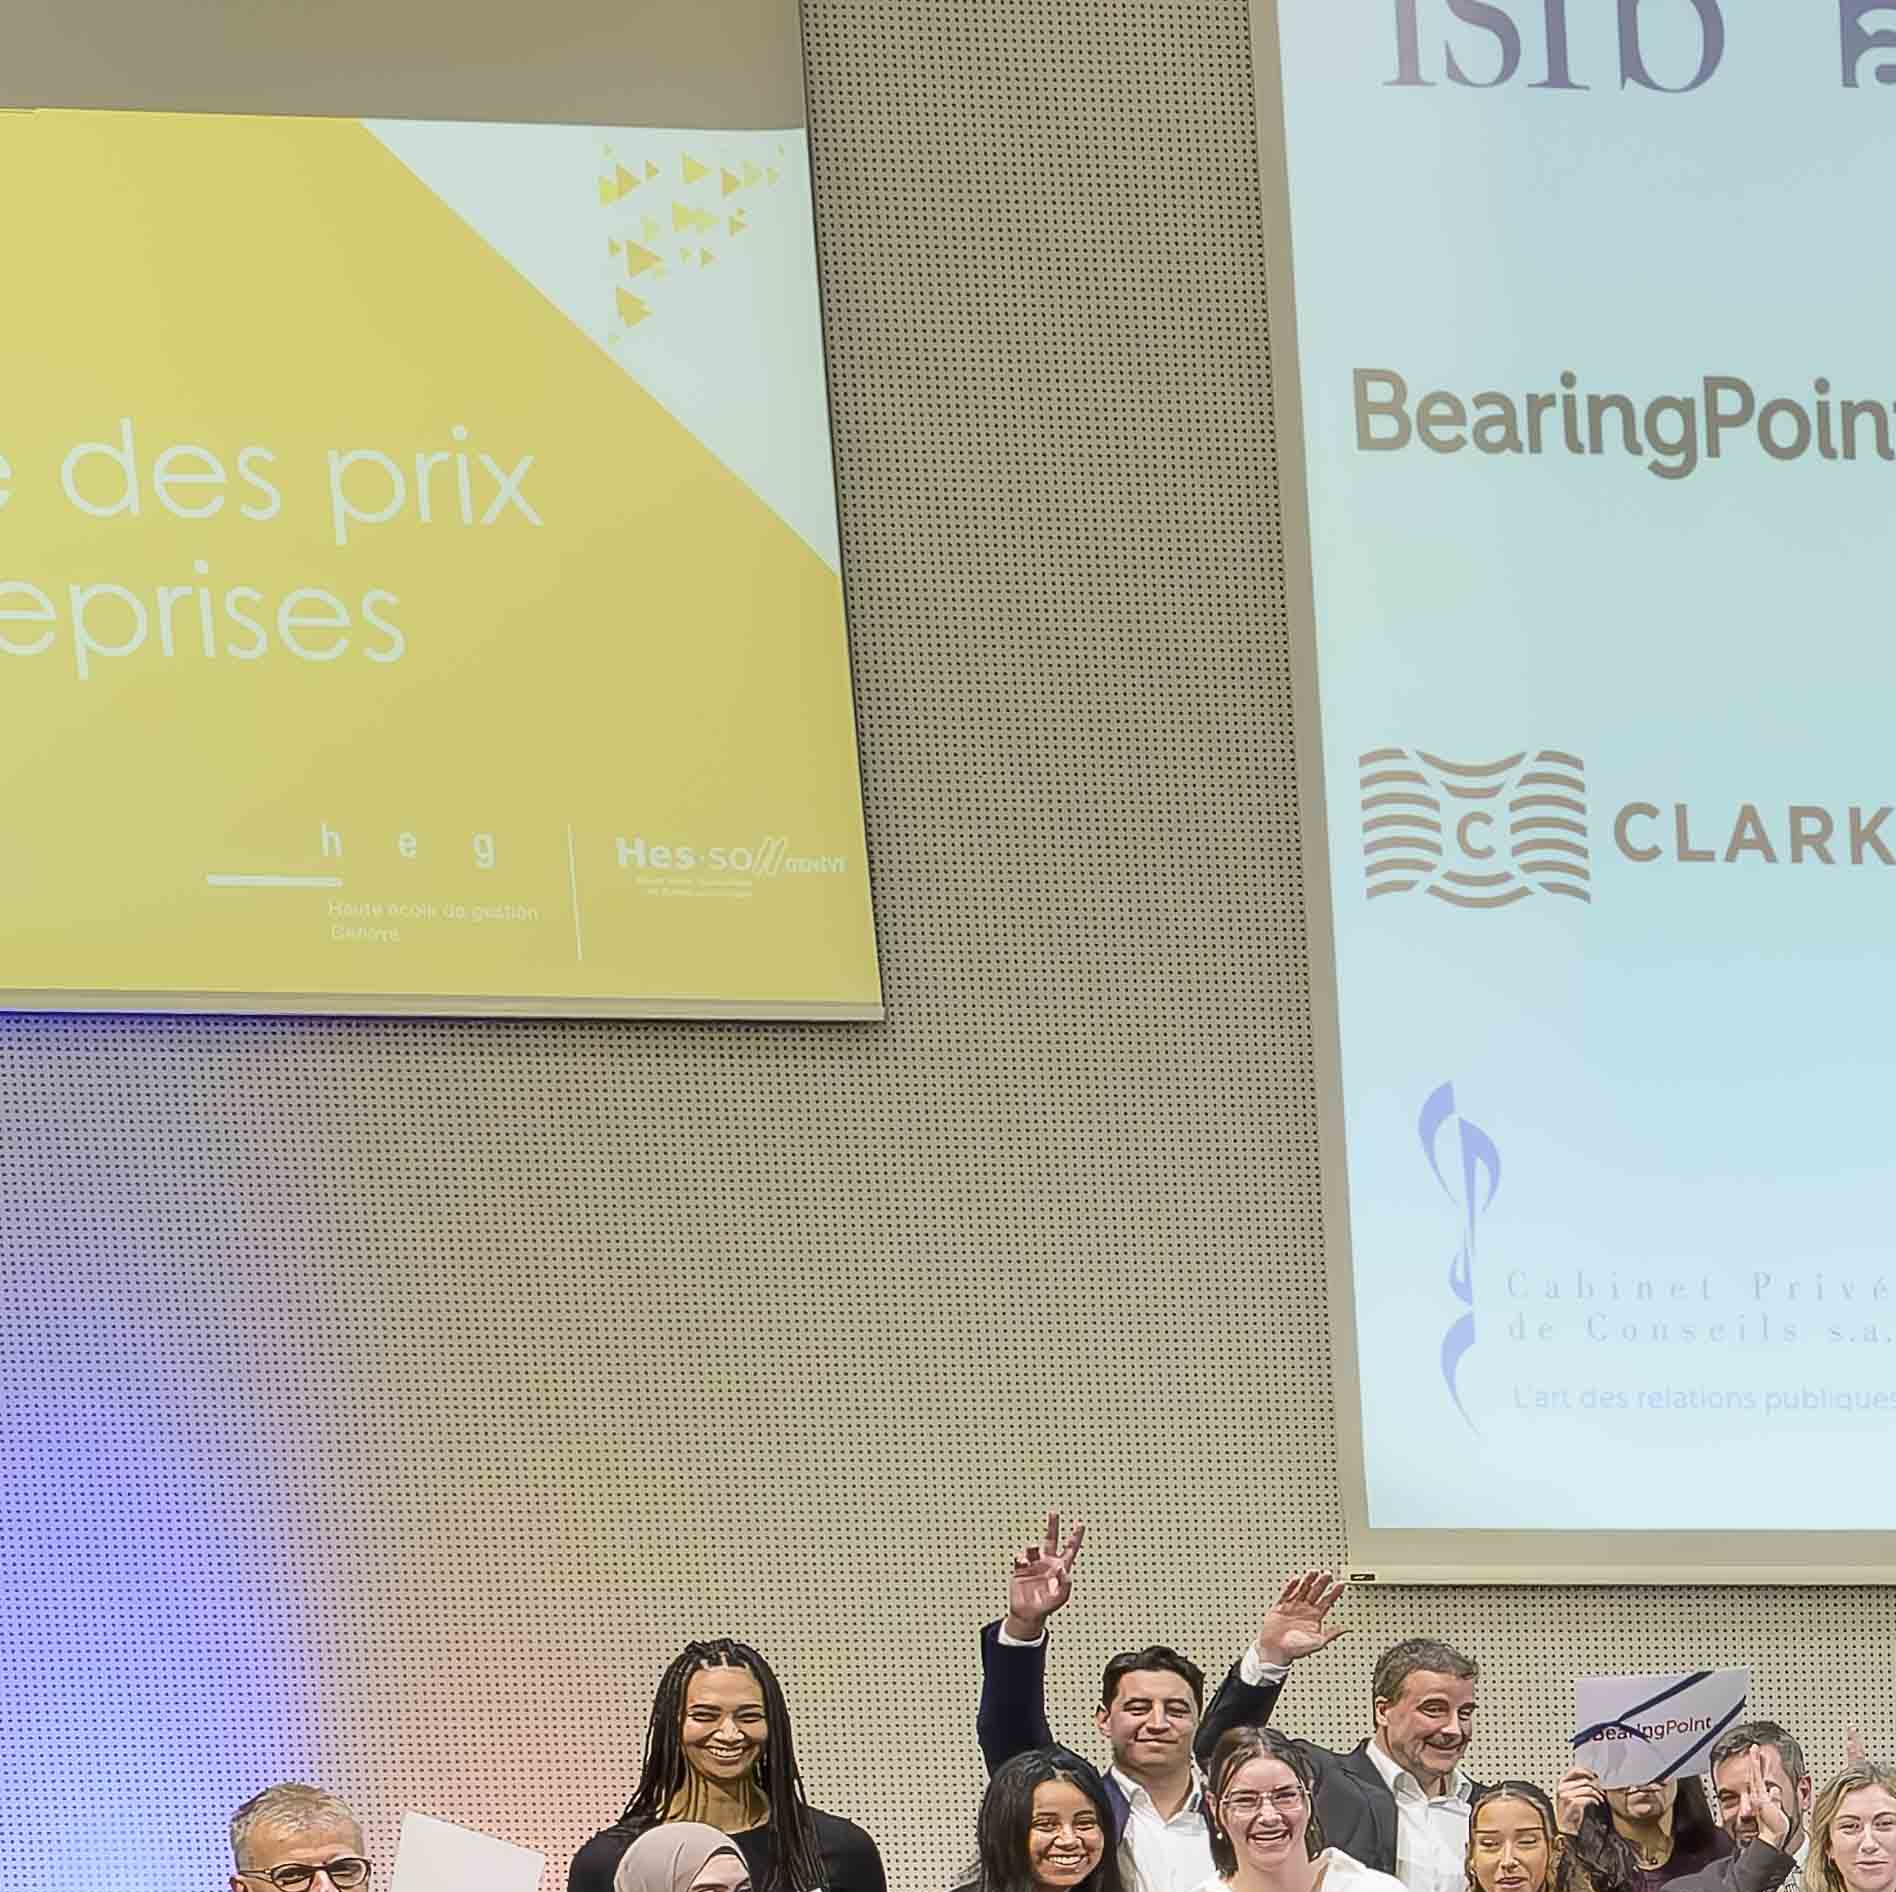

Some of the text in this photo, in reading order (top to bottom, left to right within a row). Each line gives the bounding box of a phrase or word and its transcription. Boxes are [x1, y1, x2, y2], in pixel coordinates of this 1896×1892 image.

[60, 417, 282, 522] des
[327, 425, 543, 546] prix
[1507, 1269, 1890, 1302] Cabinet Privé
[1508, 1311, 1894, 1346] de Conseils s.a.
[1577, 1384, 1630, 1410] des
[1636, 1384, 1757, 1410] relations
